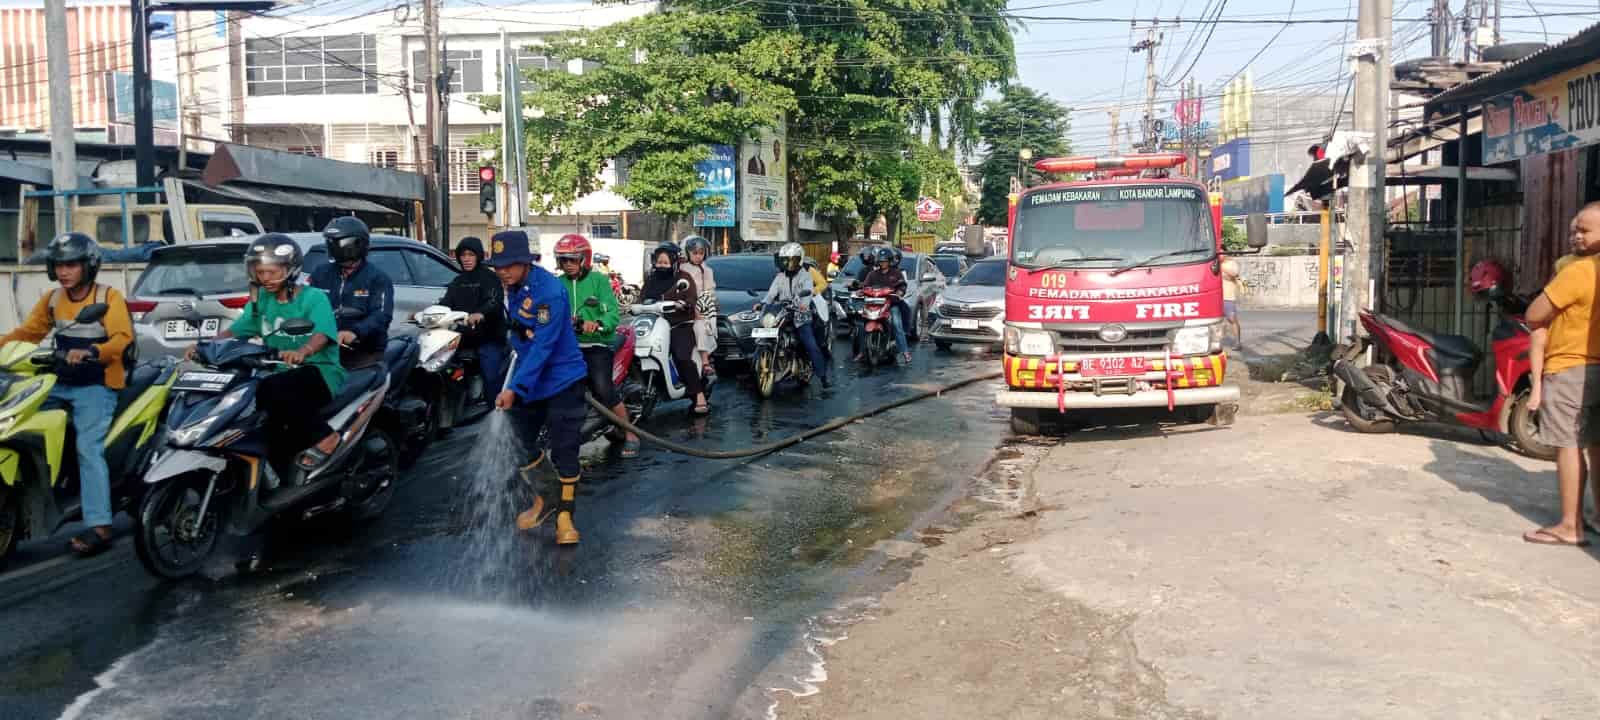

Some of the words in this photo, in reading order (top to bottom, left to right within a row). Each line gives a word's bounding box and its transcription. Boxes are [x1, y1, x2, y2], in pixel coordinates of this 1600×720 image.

[1031, 192, 1062, 206] PEMADAM
[1063, 190, 1101, 201] KEBAKARAN
[1119, 189, 1137, 200] KOTA
[1137, 187, 1164, 199] BANDAR
[1164, 185, 1196, 199] LAMPUNG
[1041, 273, 1067, 288] 019
[1028, 287, 1101, 300] PEMADAM
[1105, 284, 1200, 300] KEBAKARAN
[1135, 302, 1200, 318] FIRE
[1082, 359, 1095, 370] BE
[1100, 358, 1126, 369] 9102
